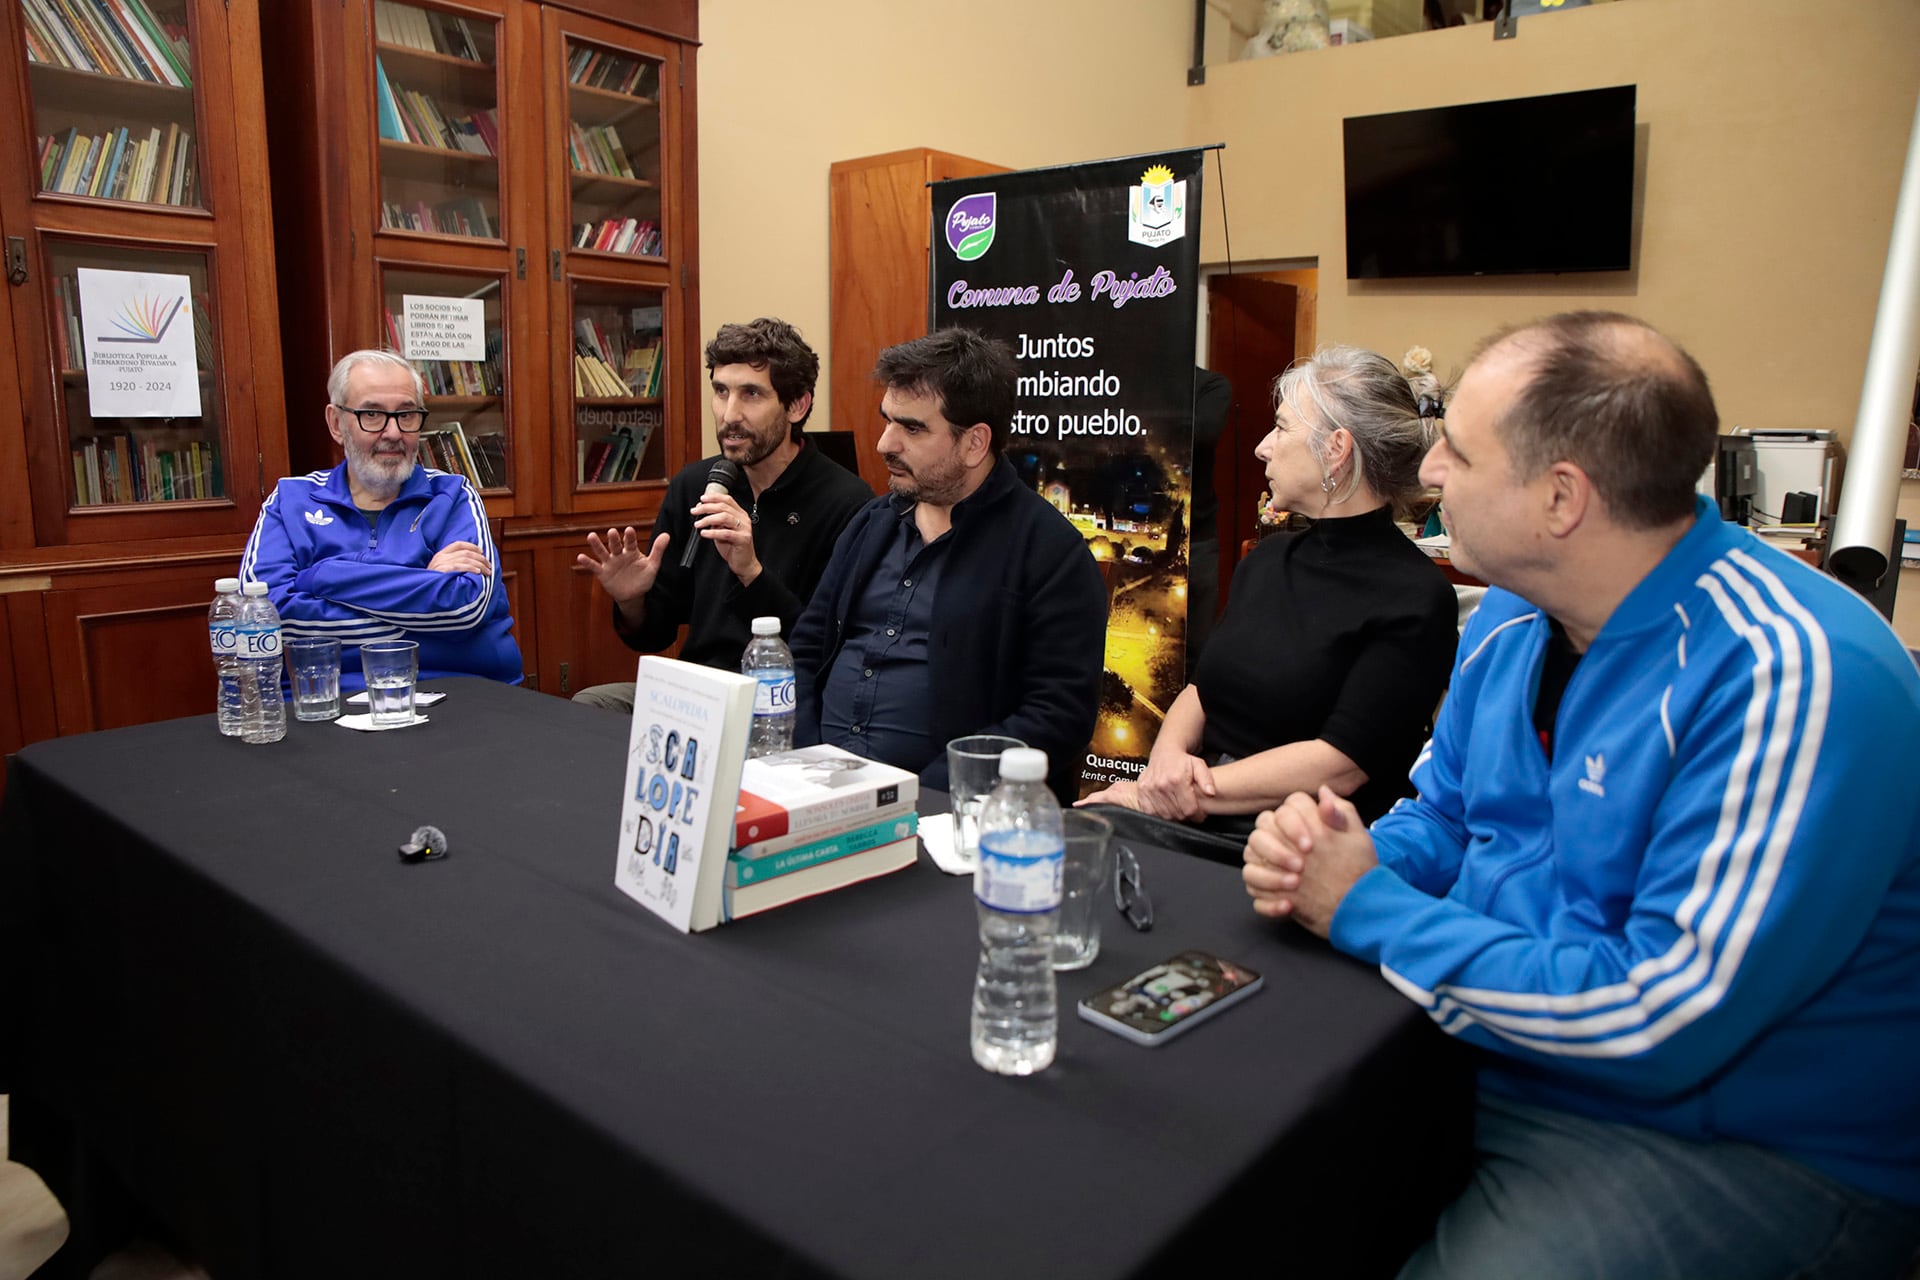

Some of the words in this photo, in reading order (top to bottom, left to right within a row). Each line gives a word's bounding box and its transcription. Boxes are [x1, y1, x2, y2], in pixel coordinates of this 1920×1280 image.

[952, 211, 991, 232] Pujato
[1142, 229, 1171, 238] PUJATO
[947, 279, 1040, 309] Comuna
[1048, 268, 1081, 303] de
[1091, 265, 1177, 309] Pujato
[1015, 333, 1094, 360] Juntos
[110, 382, 136, 391] 1920
[146, 382, 172, 391] 2024
[1016, 368, 1120, 397] mbiando
[1010, 409, 1049, 435] stro
[1058, 408, 1148, 441] pueblo.
[1086, 754, 1147, 774] Quacqua
